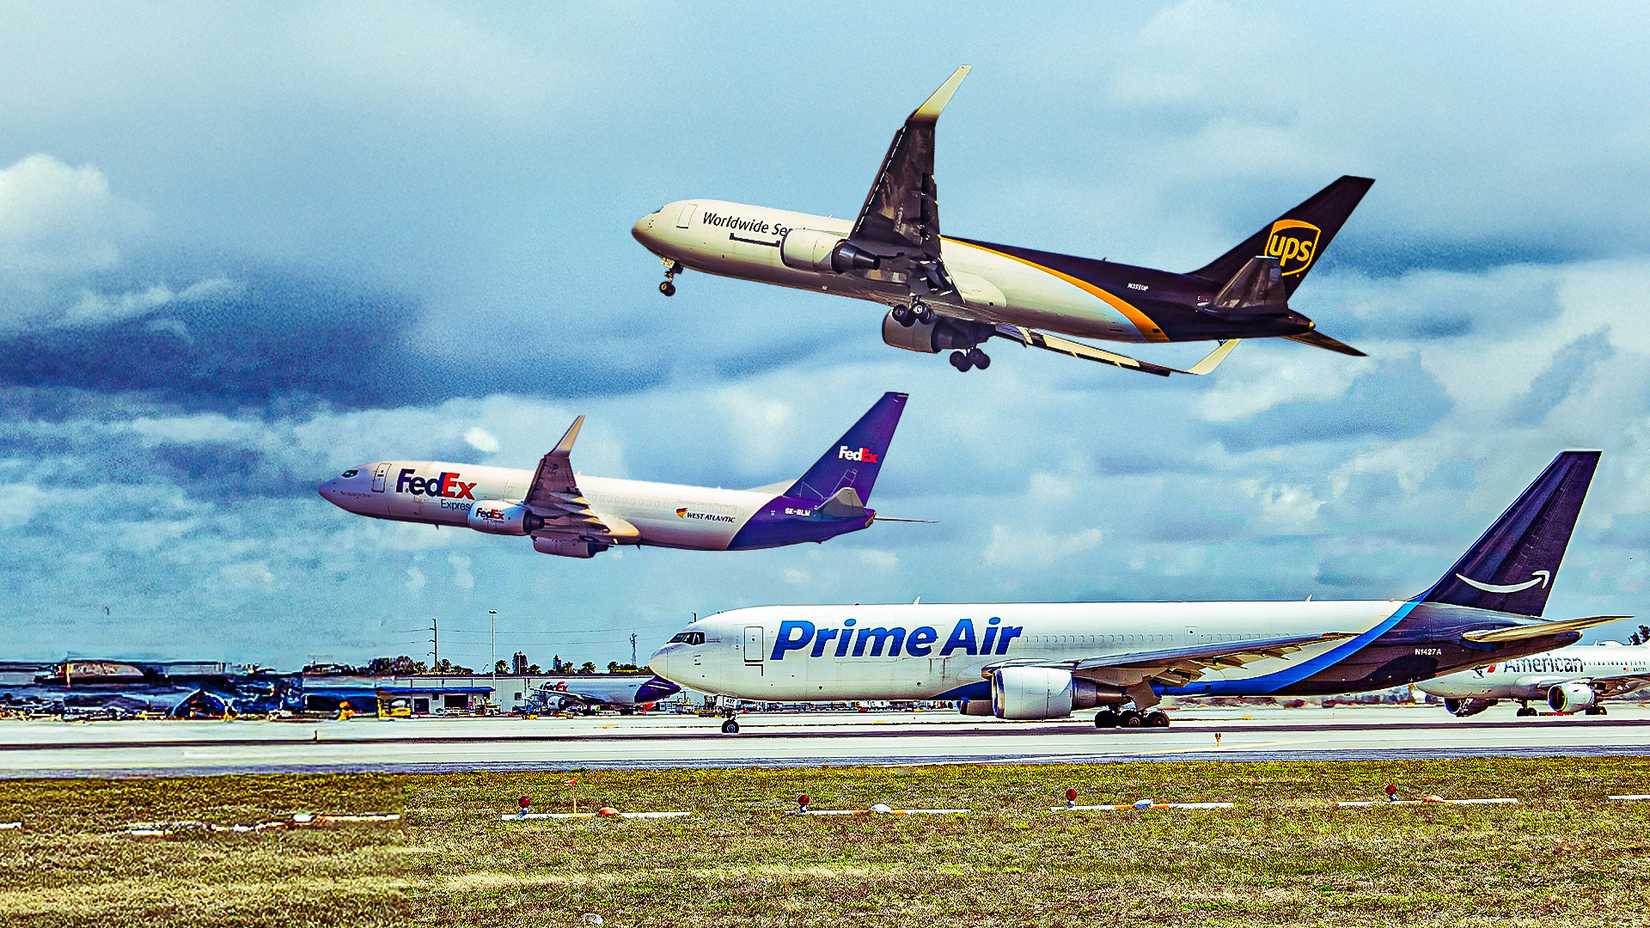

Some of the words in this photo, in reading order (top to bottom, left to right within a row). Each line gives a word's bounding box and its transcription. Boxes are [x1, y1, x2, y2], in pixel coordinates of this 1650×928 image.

[703, 212, 769, 234] Worldwide
[1269, 234, 1313, 266] ups
[839, 445, 880, 464] FedEx
[396, 468, 477, 500] FedEx
[475, 507, 505, 520] FedEx
[687, 512, 705, 520] WEST
[705, 514, 736, 523] ATLANTIC
[769, 618, 939, 660] Prime
[939, 616, 1023, 656] Air
[1414, 648, 1442, 656] N1427A
[1503, 652, 1584, 673] American
